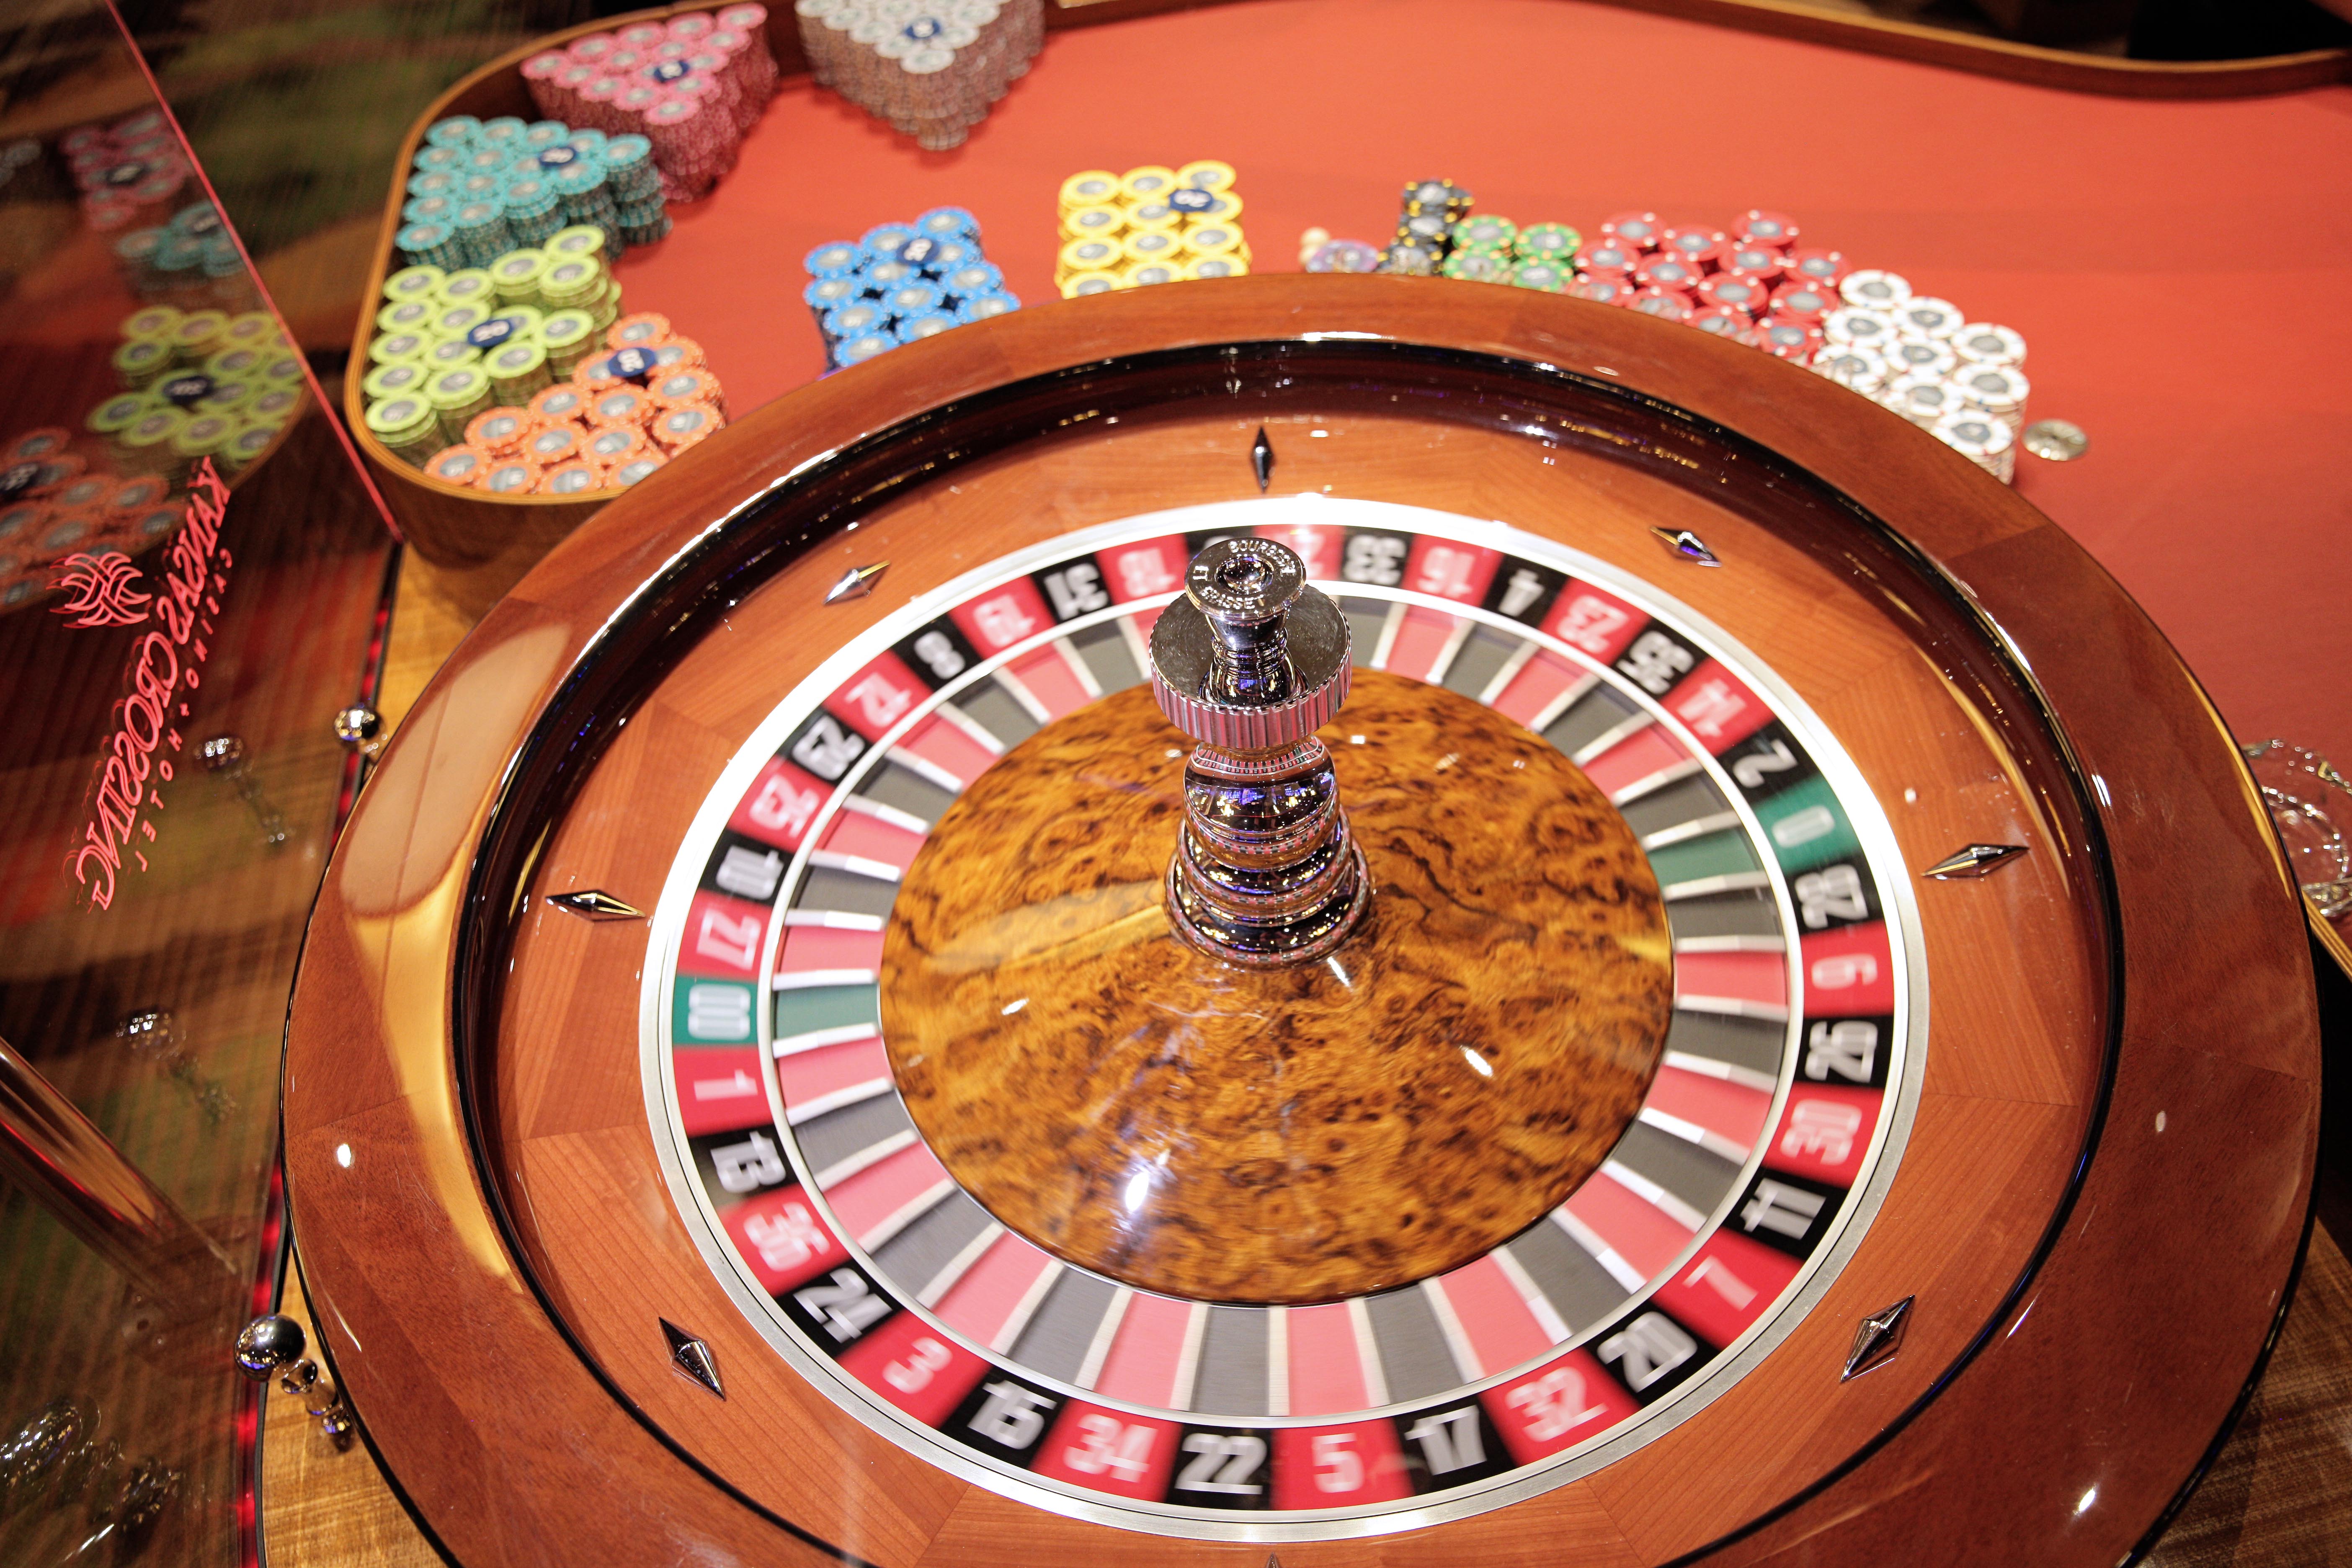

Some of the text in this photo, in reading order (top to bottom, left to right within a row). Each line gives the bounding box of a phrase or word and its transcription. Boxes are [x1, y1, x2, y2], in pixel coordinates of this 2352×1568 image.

[1044, 563, 1110, 615] 31
[1342, 535, 1408, 585] 33
[1419, 546, 1476, 599] 16
[1499, 569, 1544, 617] 4
[1556, 594, 1630, 654] 23
[913, 631, 966, 678] 8
[1616, 631, 1694, 694] 35
[1676, 679, 1746, 738] 14
[1733, 739, 1798, 787] 2
[1772, 805, 1835, 848] 0
[716, 845, 784, 900] 10
[1795, 864, 1868, 929] 28
[695, 909, 762, 969] 27
[1812, 954, 1877, 990] 9
[686, 982, 752, 1040] 00
[1805, 1020, 1877, 1083] 26
[693, 1069, 758, 1101] 1
[1781, 1099, 1862, 1164] 30
[709, 1130, 788, 1194] 13
[742, 1201, 830, 1273] 36
[1740, 1178, 1825, 1240] 11
[794, 1267, 892, 1344] 24
[1683, 1256, 1758, 1311] 7
[881, 1335, 952, 1395] 3
[1598, 1311, 1698, 1390] 20
[968, 1380, 1059, 1450] 15
[1504, 1366, 1607, 1443] 32
[1063, 1413, 1159, 1482] 34
[1175, 1433, 1267, 1495] 22
[1312, 1432, 1365, 1493] 5
[1404, 1406, 1485, 1475] 17
